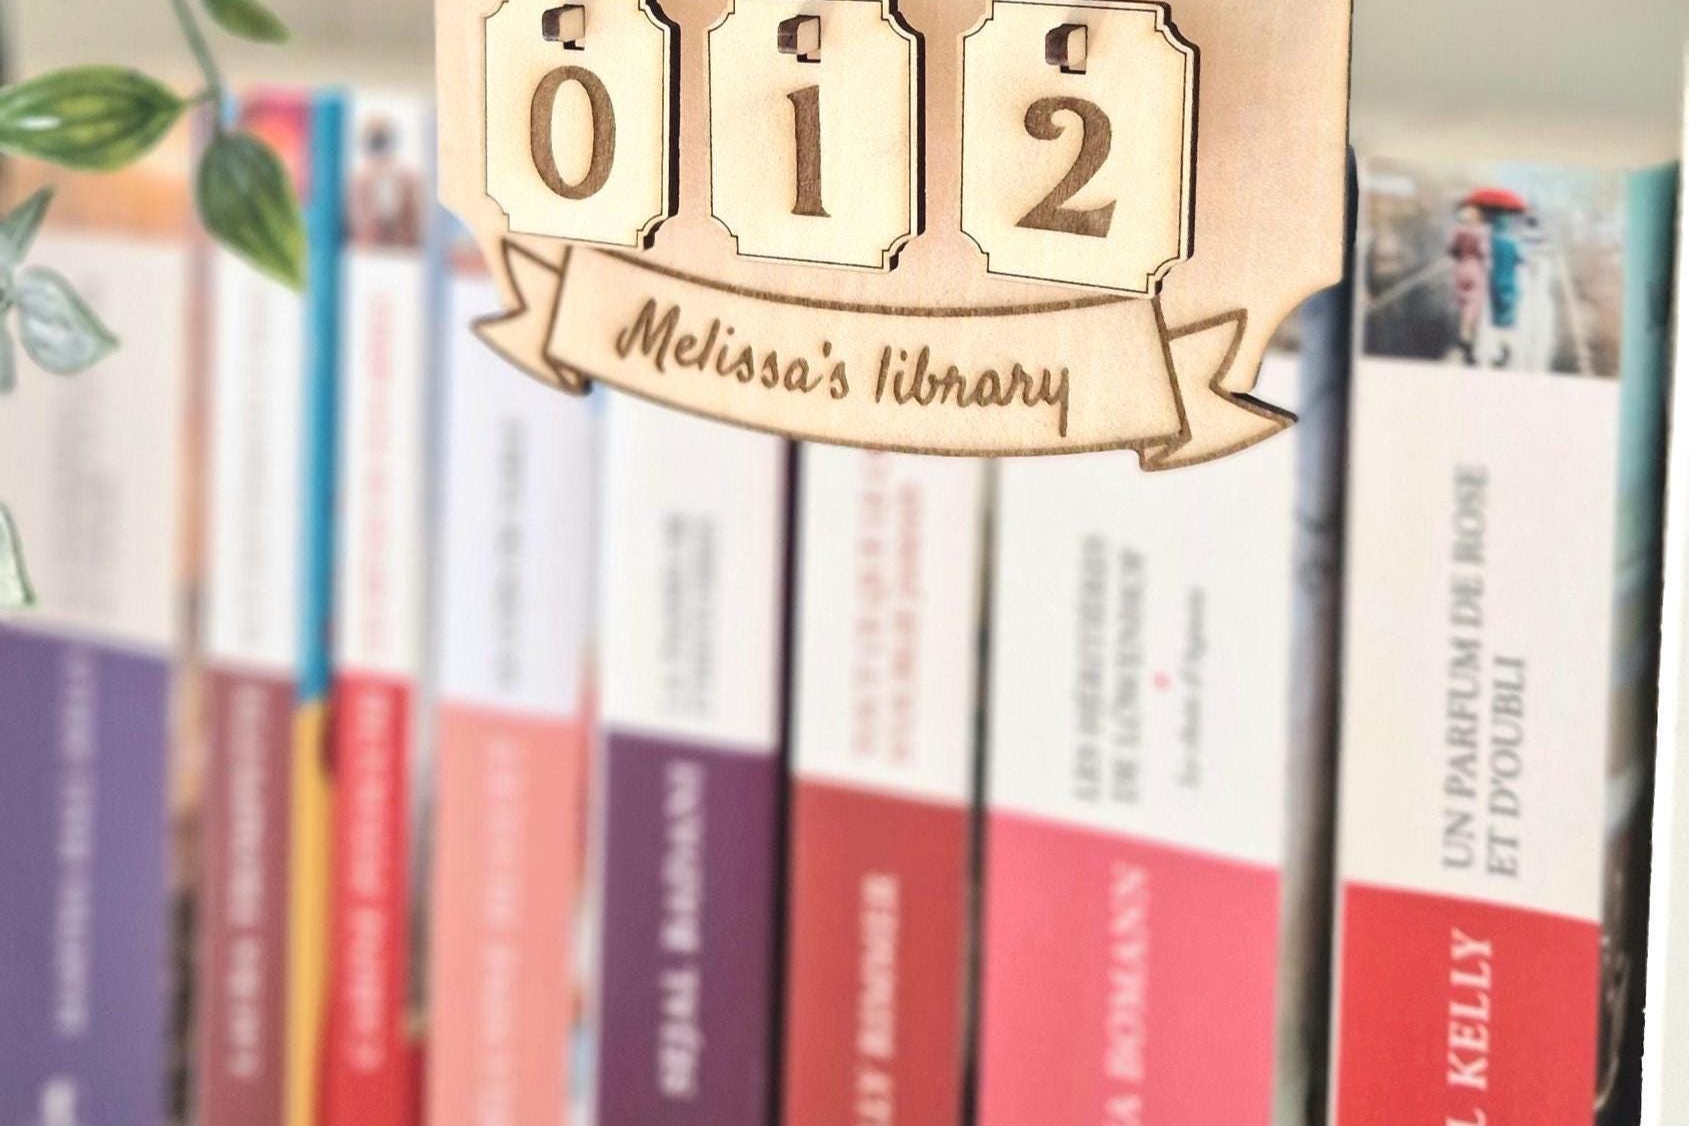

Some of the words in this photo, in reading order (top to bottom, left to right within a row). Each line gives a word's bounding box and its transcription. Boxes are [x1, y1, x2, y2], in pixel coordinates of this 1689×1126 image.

[529, 65, 617, 201] 0
[1014, 95, 1117, 239] 2
[616, 299, 850, 399] Melissa's
[874, 346, 1071, 437] library
[1449, 463, 1489, 564] ROSE
[1450, 573, 1485, 628] DE
[1444, 639, 1484, 800] PARFUM
[1488, 655, 1526, 818] D'OUBLI
[1442, 809, 1477, 871] UN
[1486, 828, 1520, 879] ET
[1446, 927, 1493, 1090] KELLY
